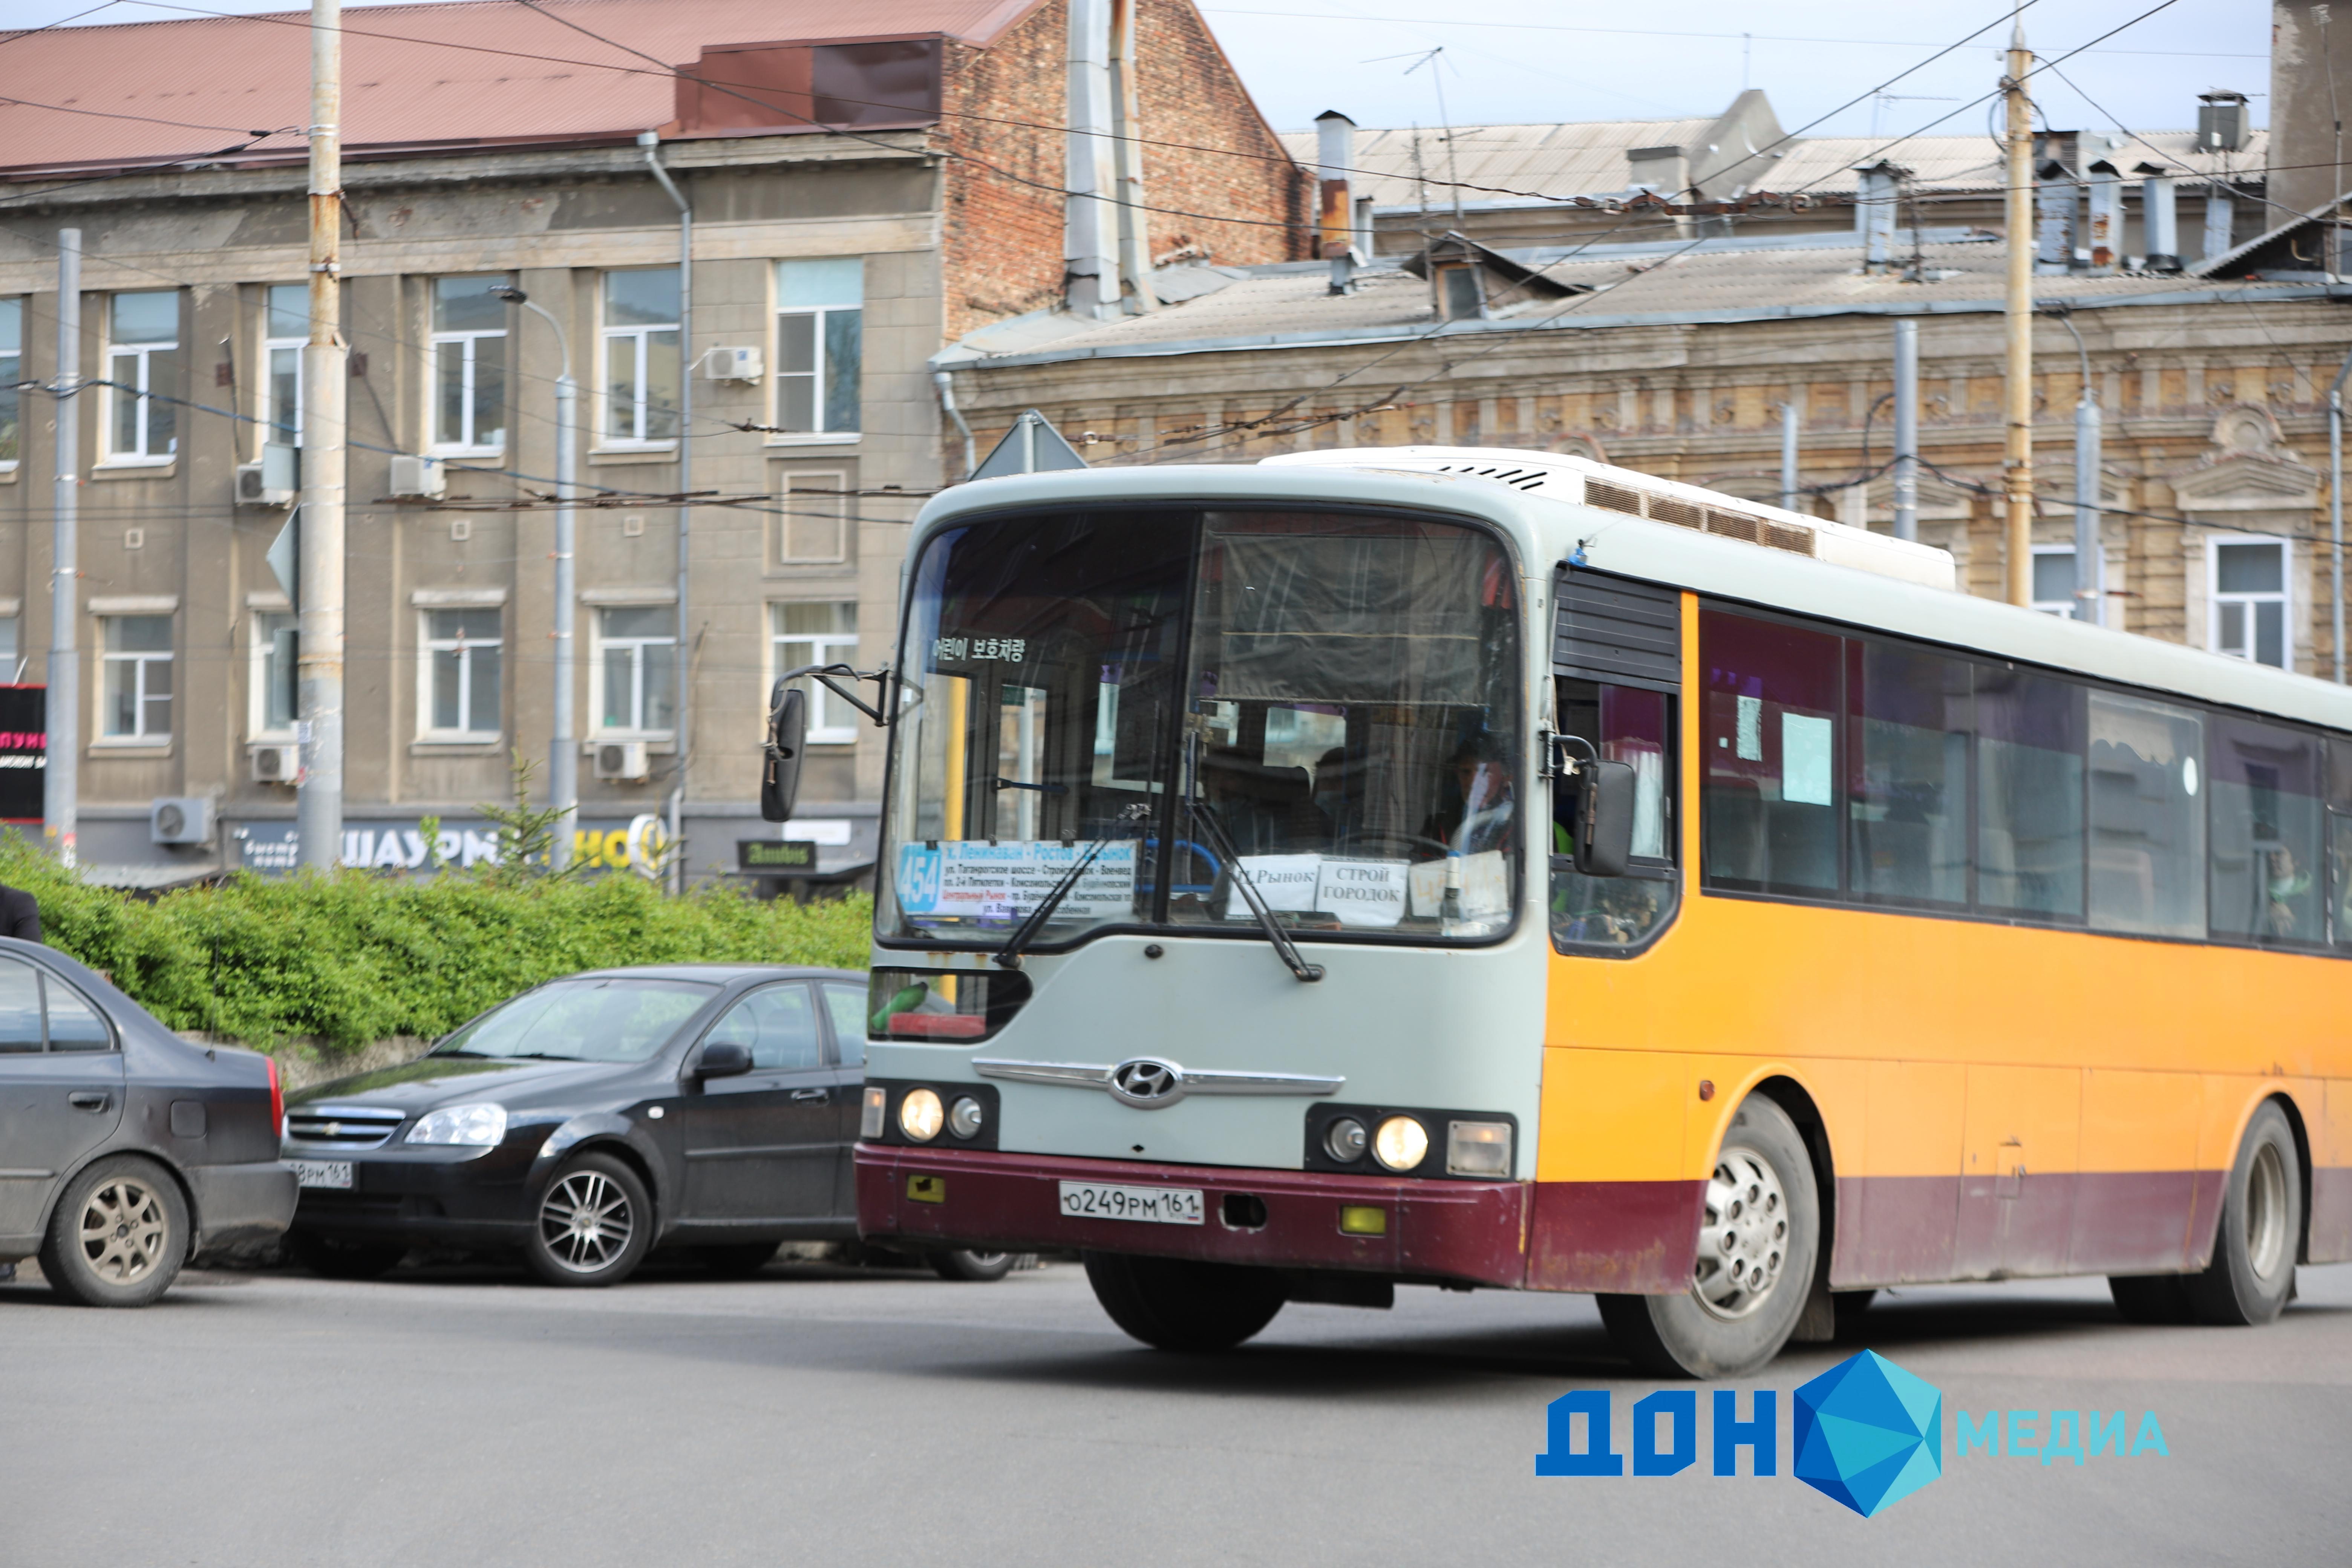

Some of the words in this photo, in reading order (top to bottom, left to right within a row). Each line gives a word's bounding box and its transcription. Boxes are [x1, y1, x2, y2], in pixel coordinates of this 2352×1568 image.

[932, 637, 968, 661] 어린이
[971, 639, 1025, 662] 보호차량
[960, 843, 1023, 860] Ленинаван
[1034, 843, 1074, 860] Ростов
[944, 867, 955, 876] ул.
[958, 864, 1008, 876] Таганрогское
[1336, 867, 1390, 882] СТРОЙ
[898, 856, 939, 903] 454
[1323, 886, 1401, 902] ГОРОДОК
[1161, 1193, 1195, 1213] 161
